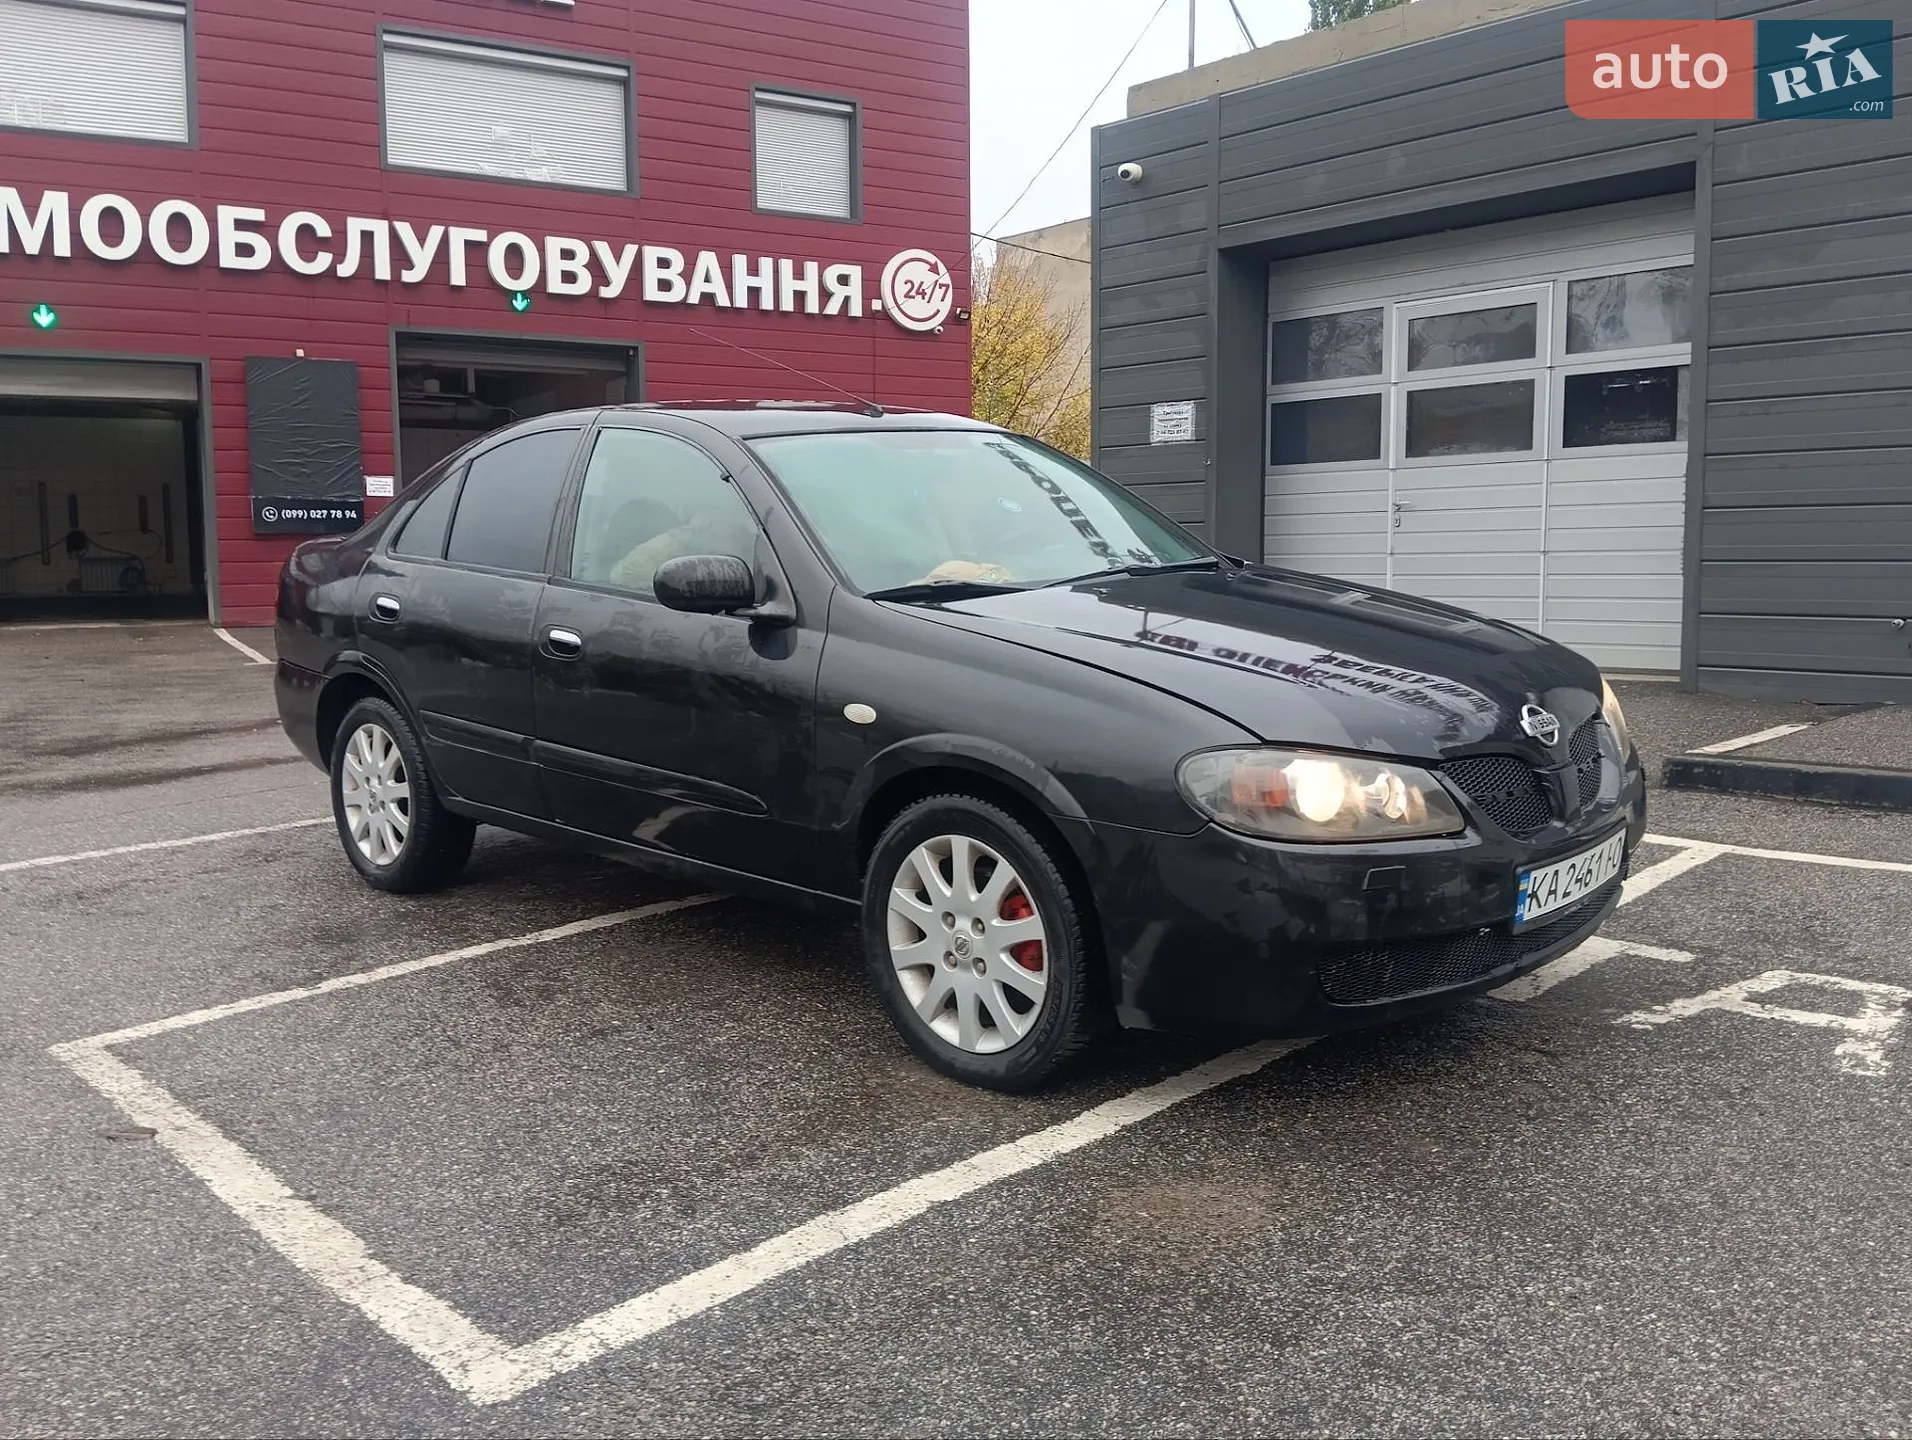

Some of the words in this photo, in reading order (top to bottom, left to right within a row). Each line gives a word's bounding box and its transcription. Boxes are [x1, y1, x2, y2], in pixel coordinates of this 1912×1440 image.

[0, 186, 863, 317] МООБСЛУГОВУВАННЯ
[903, 279, 950, 304] 24/7
[281, 509, 308, 519] (099)
[309, 509, 328, 519] 027
[329, 509, 343, 519] 78
[344, 509, 357, 519] 94
